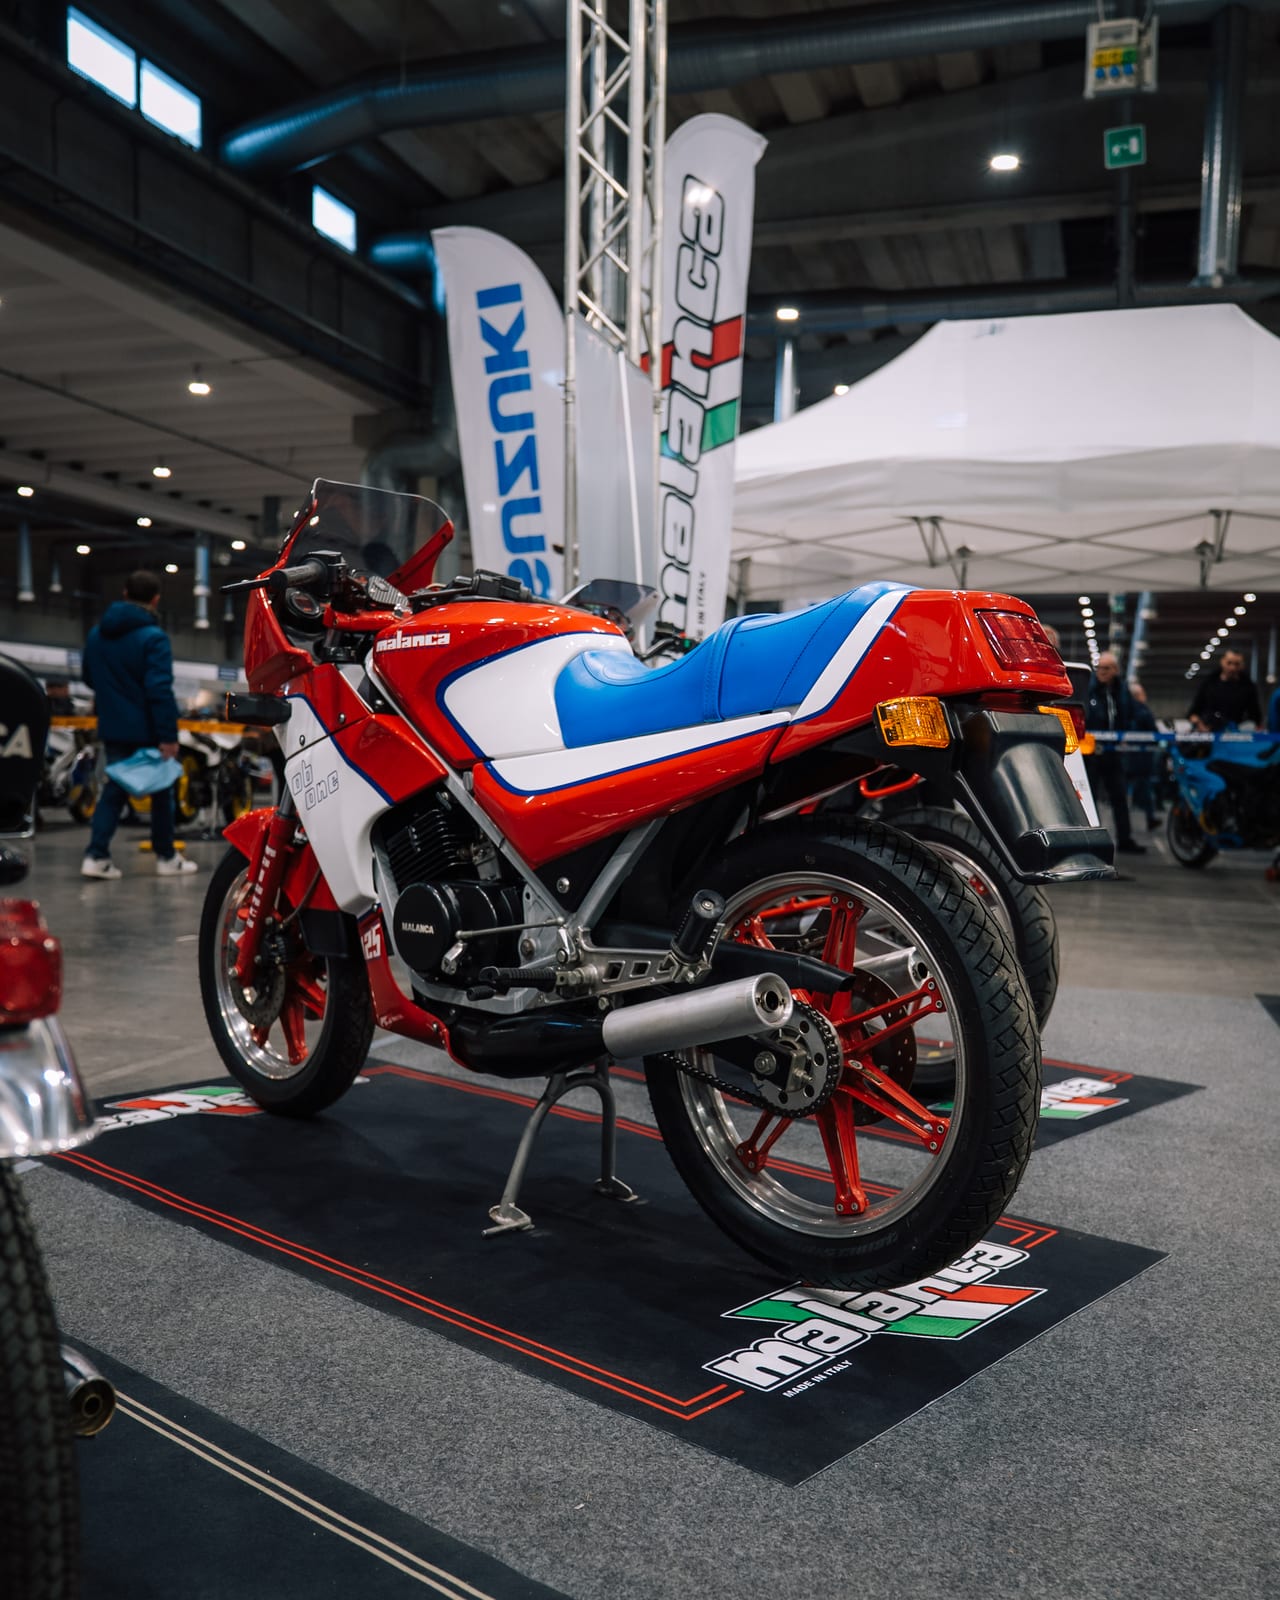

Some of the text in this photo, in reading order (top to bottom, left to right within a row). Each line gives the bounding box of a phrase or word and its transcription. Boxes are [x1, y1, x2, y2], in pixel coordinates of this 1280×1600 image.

[375, 630, 451, 653] malanca
[401, 921, 435, 934] MALANCA
[702, 1240, 1030, 1391] malanca
[782, 1359, 853, 1398] MADE IN ITALY
